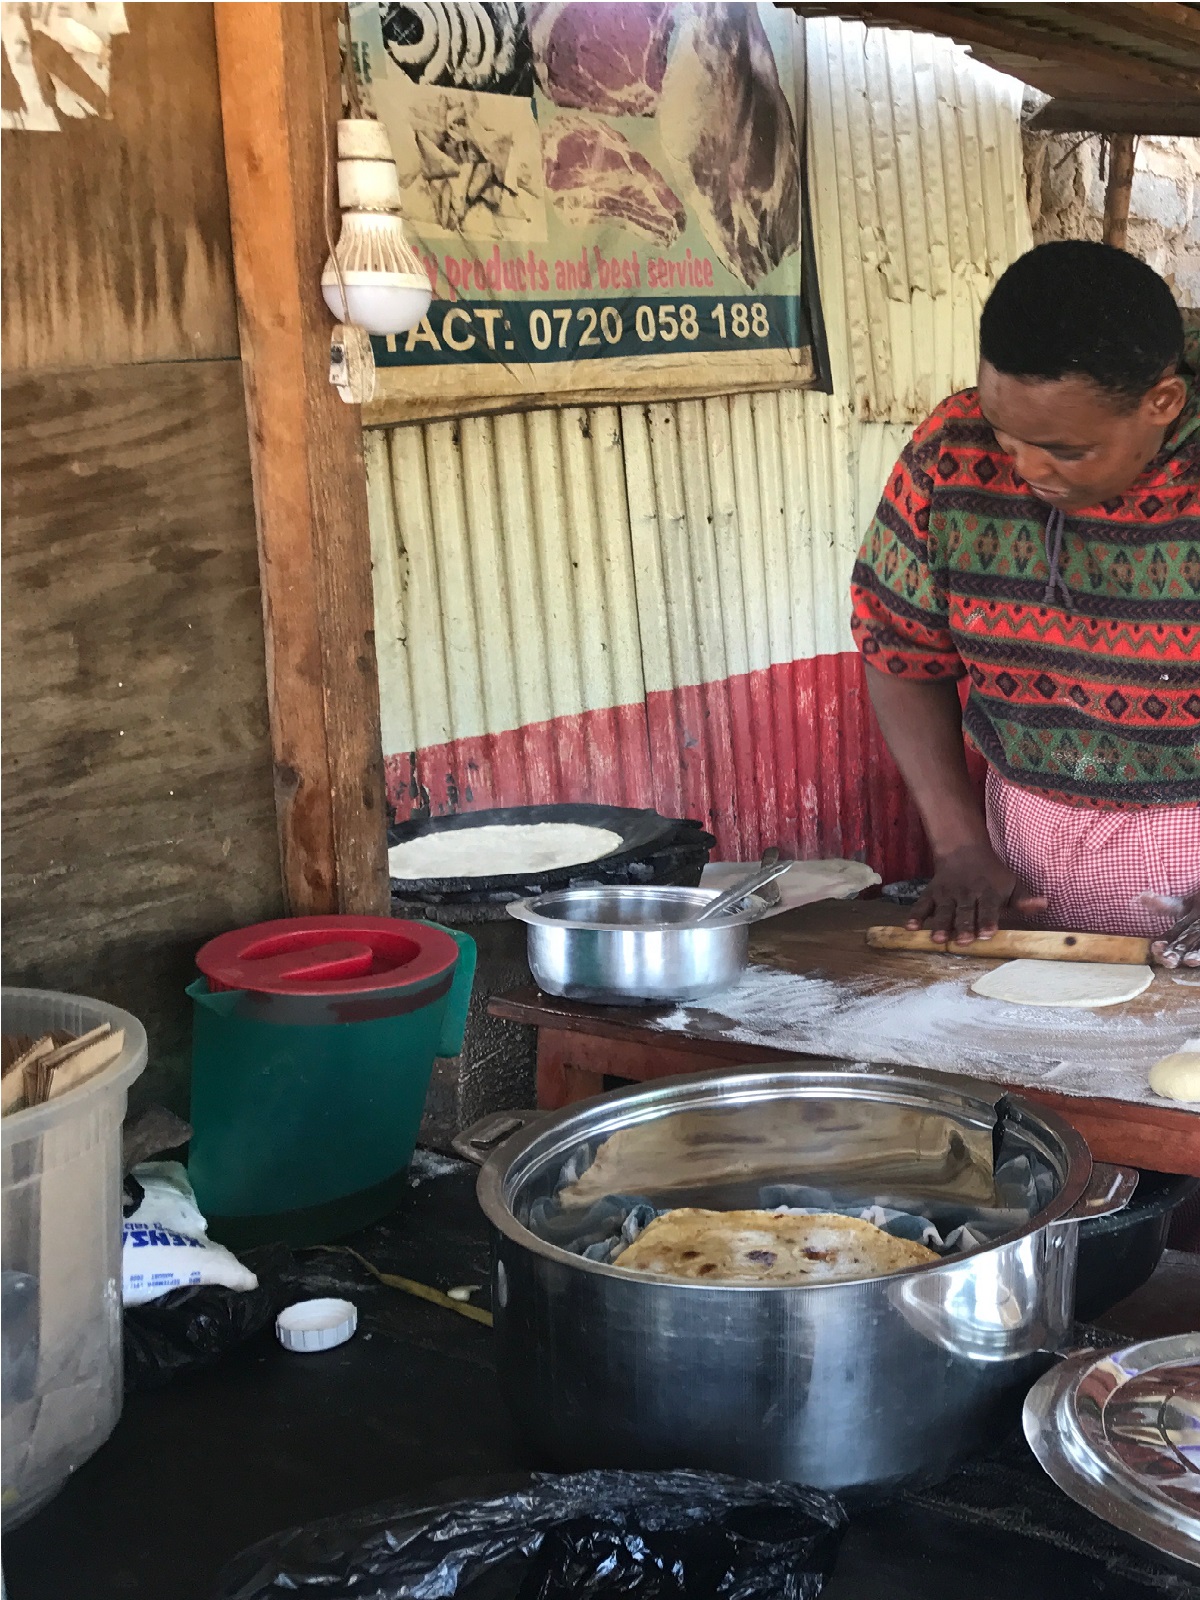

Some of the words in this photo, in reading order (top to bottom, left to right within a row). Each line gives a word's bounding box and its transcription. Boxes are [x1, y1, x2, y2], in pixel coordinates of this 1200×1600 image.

[444, 244, 550, 302] products
[555, 244, 590, 290] and
[597, 244, 641, 288] best
[647, 248, 714, 288] service
[528, 306, 623, 352] 0720
[635, 303, 700, 342] 058
[710, 301, 770, 340] 188
[147, 1278, 180, 1287] SEPTEMBER
